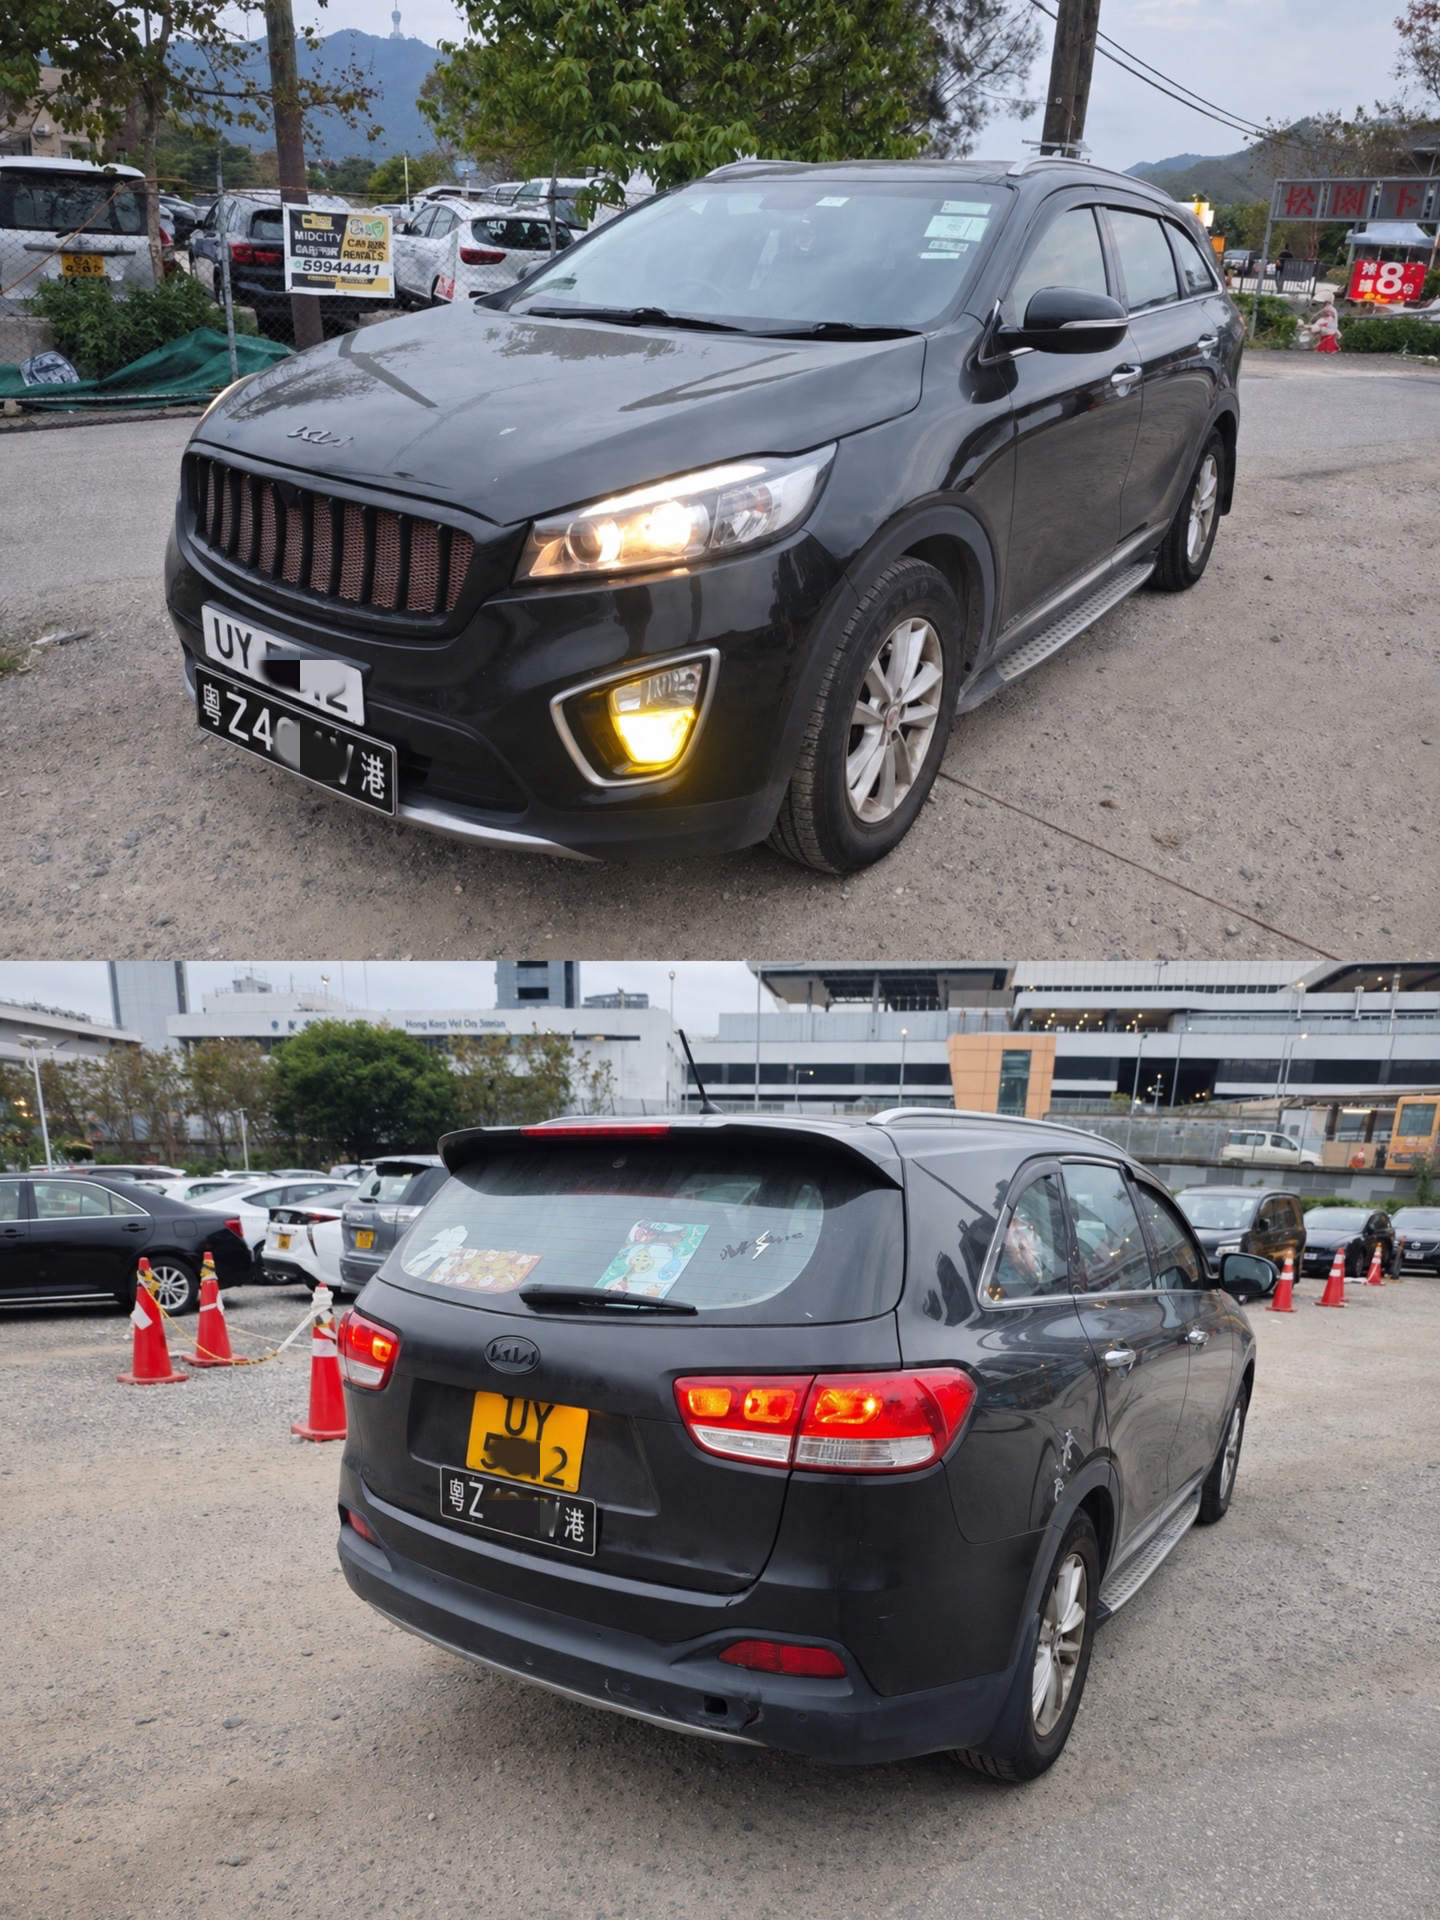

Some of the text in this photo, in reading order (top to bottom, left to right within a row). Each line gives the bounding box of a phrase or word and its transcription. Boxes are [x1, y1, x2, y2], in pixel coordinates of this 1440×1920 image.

[294, 230, 342, 243] MIDCITY
[302, 260, 380, 276] 59944441
[1376, 262, 1404, 294] 8
[213, 617, 252, 670] UY
[490, 1344, 535, 1366] KIA
[505, 1396, 554, 1441] UY
